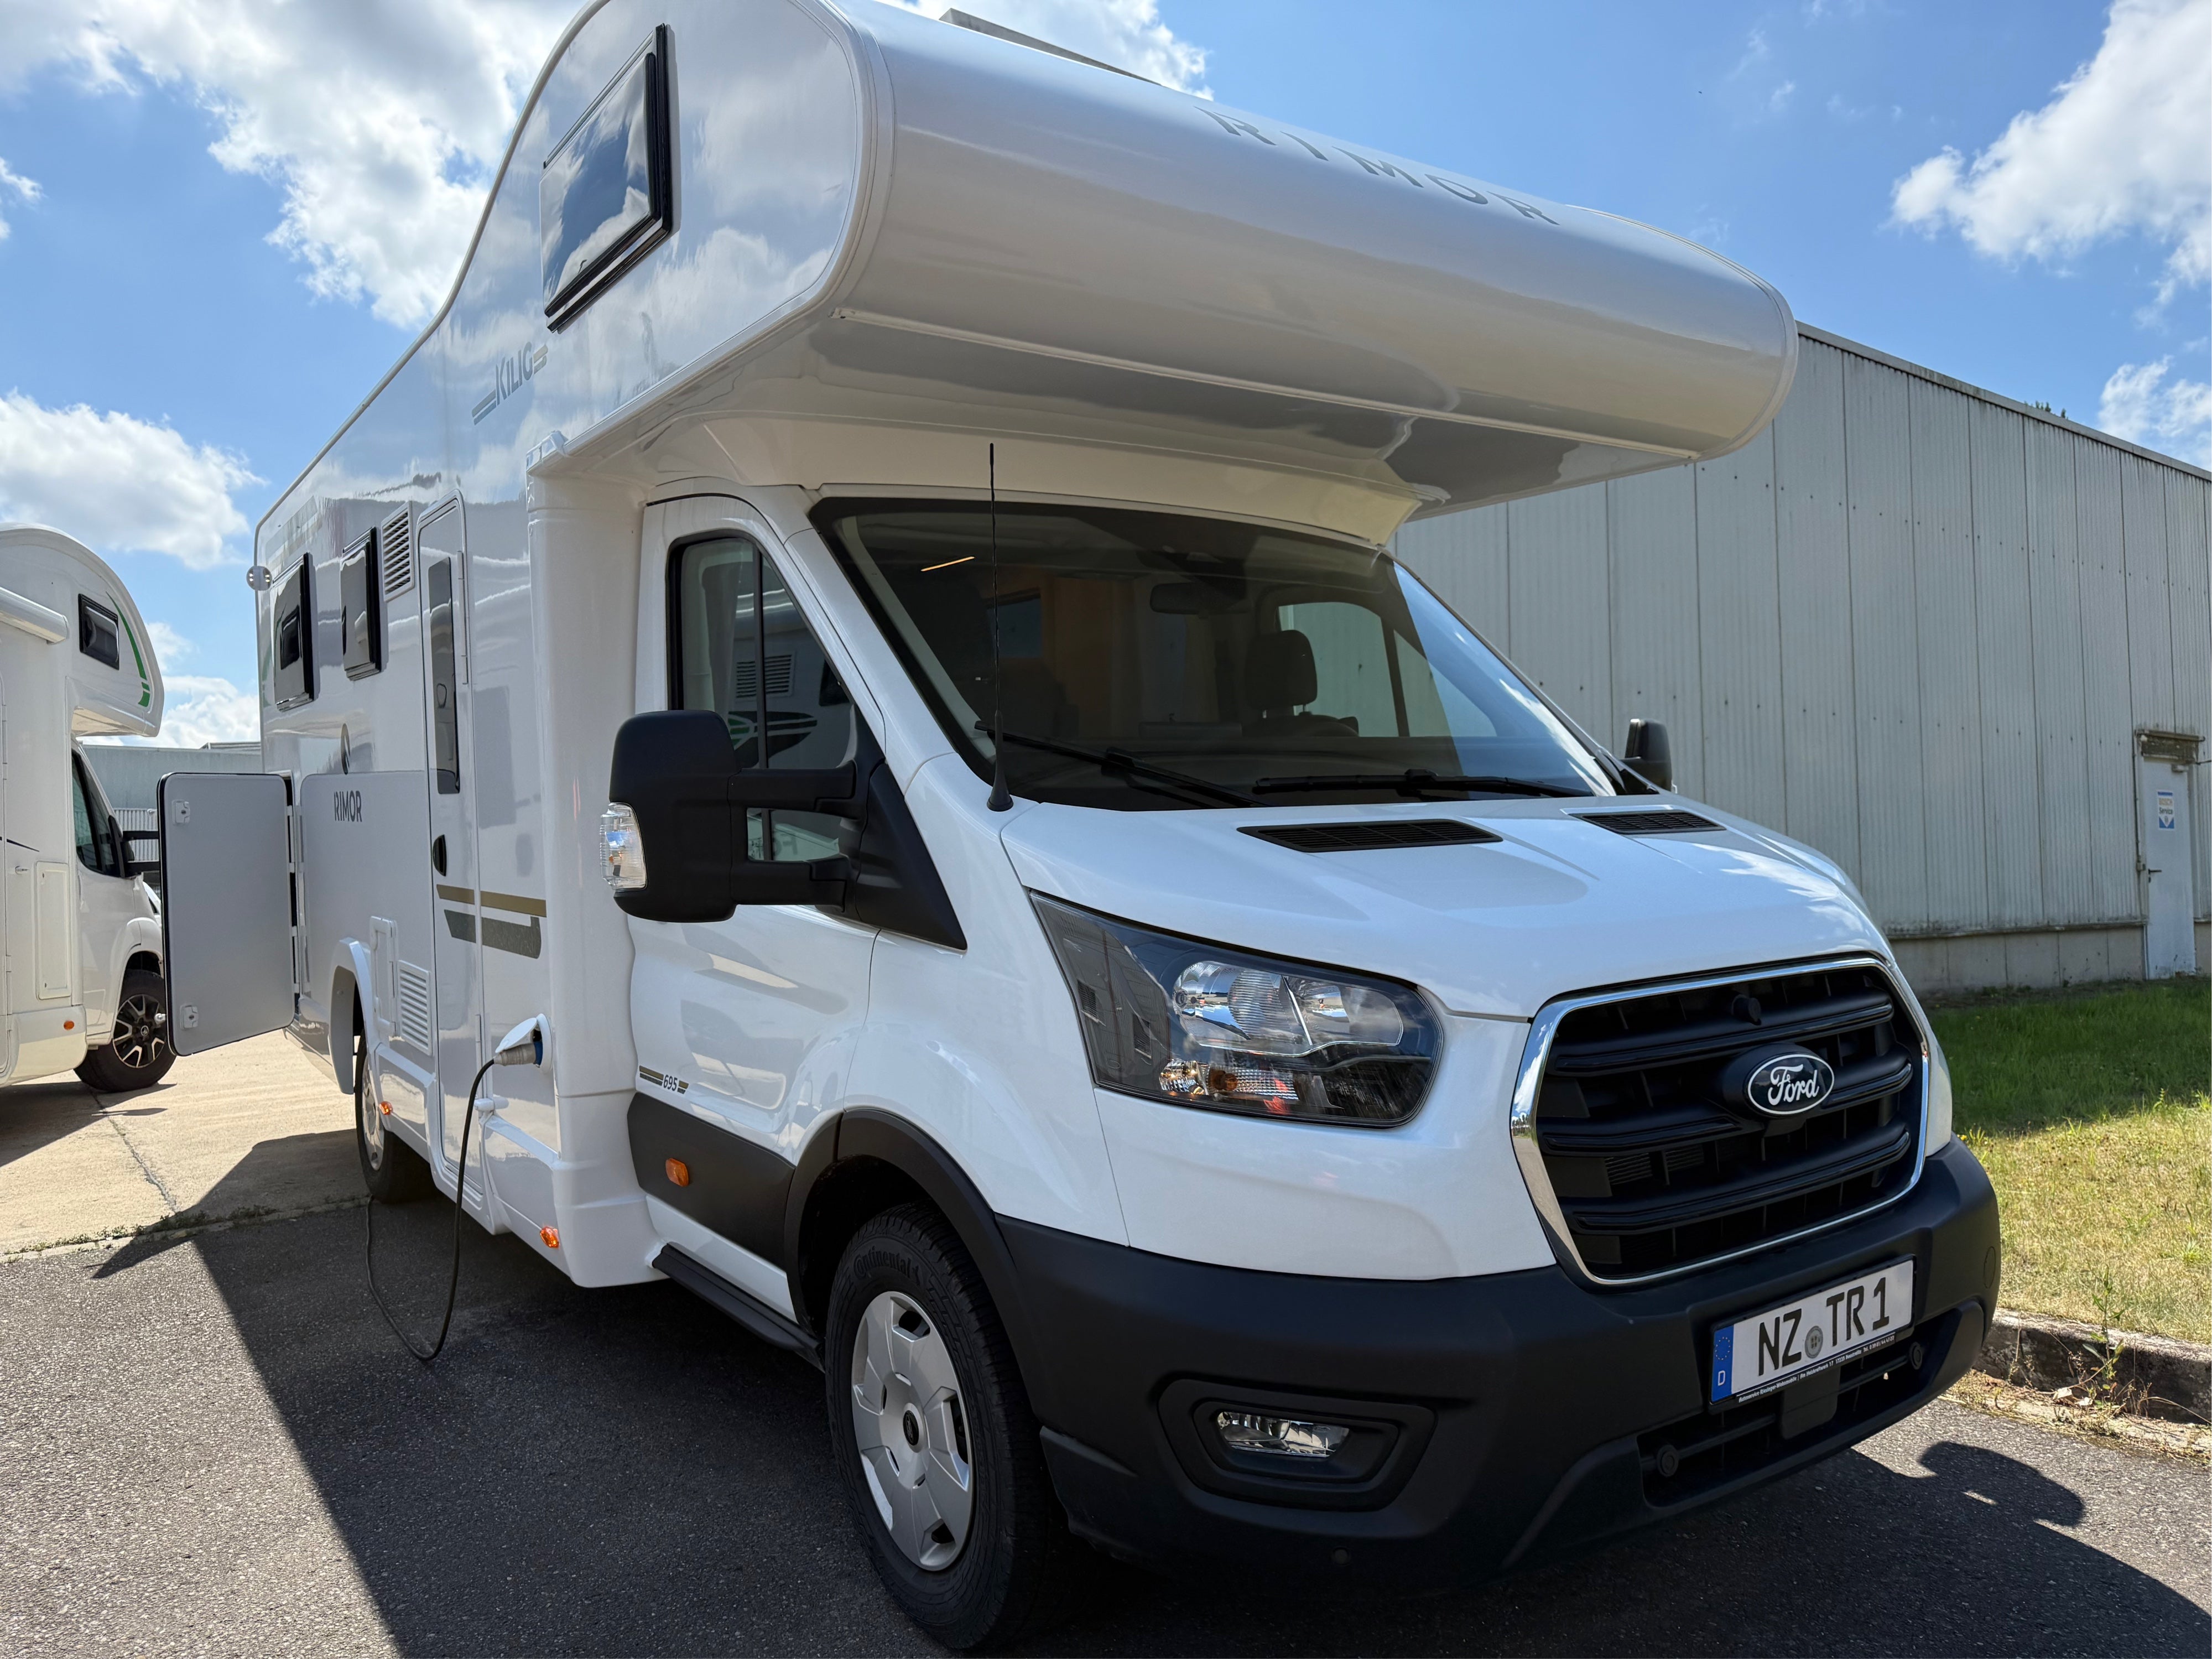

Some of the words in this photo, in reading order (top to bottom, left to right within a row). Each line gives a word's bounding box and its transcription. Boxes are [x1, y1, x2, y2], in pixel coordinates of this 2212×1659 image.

[1194, 106, 1560, 226] RIMOR
[496, 341, 533, 406] KILIG
[334, 790, 362, 822] RIMOR
[663, 1074, 678, 1091] 695
[1767, 1064, 1820, 1106] Ford
[853, 1245, 912, 1280] Continental
[1758, 1308, 1802, 1377] NZ
[1717, 1370, 1726, 1386] D
